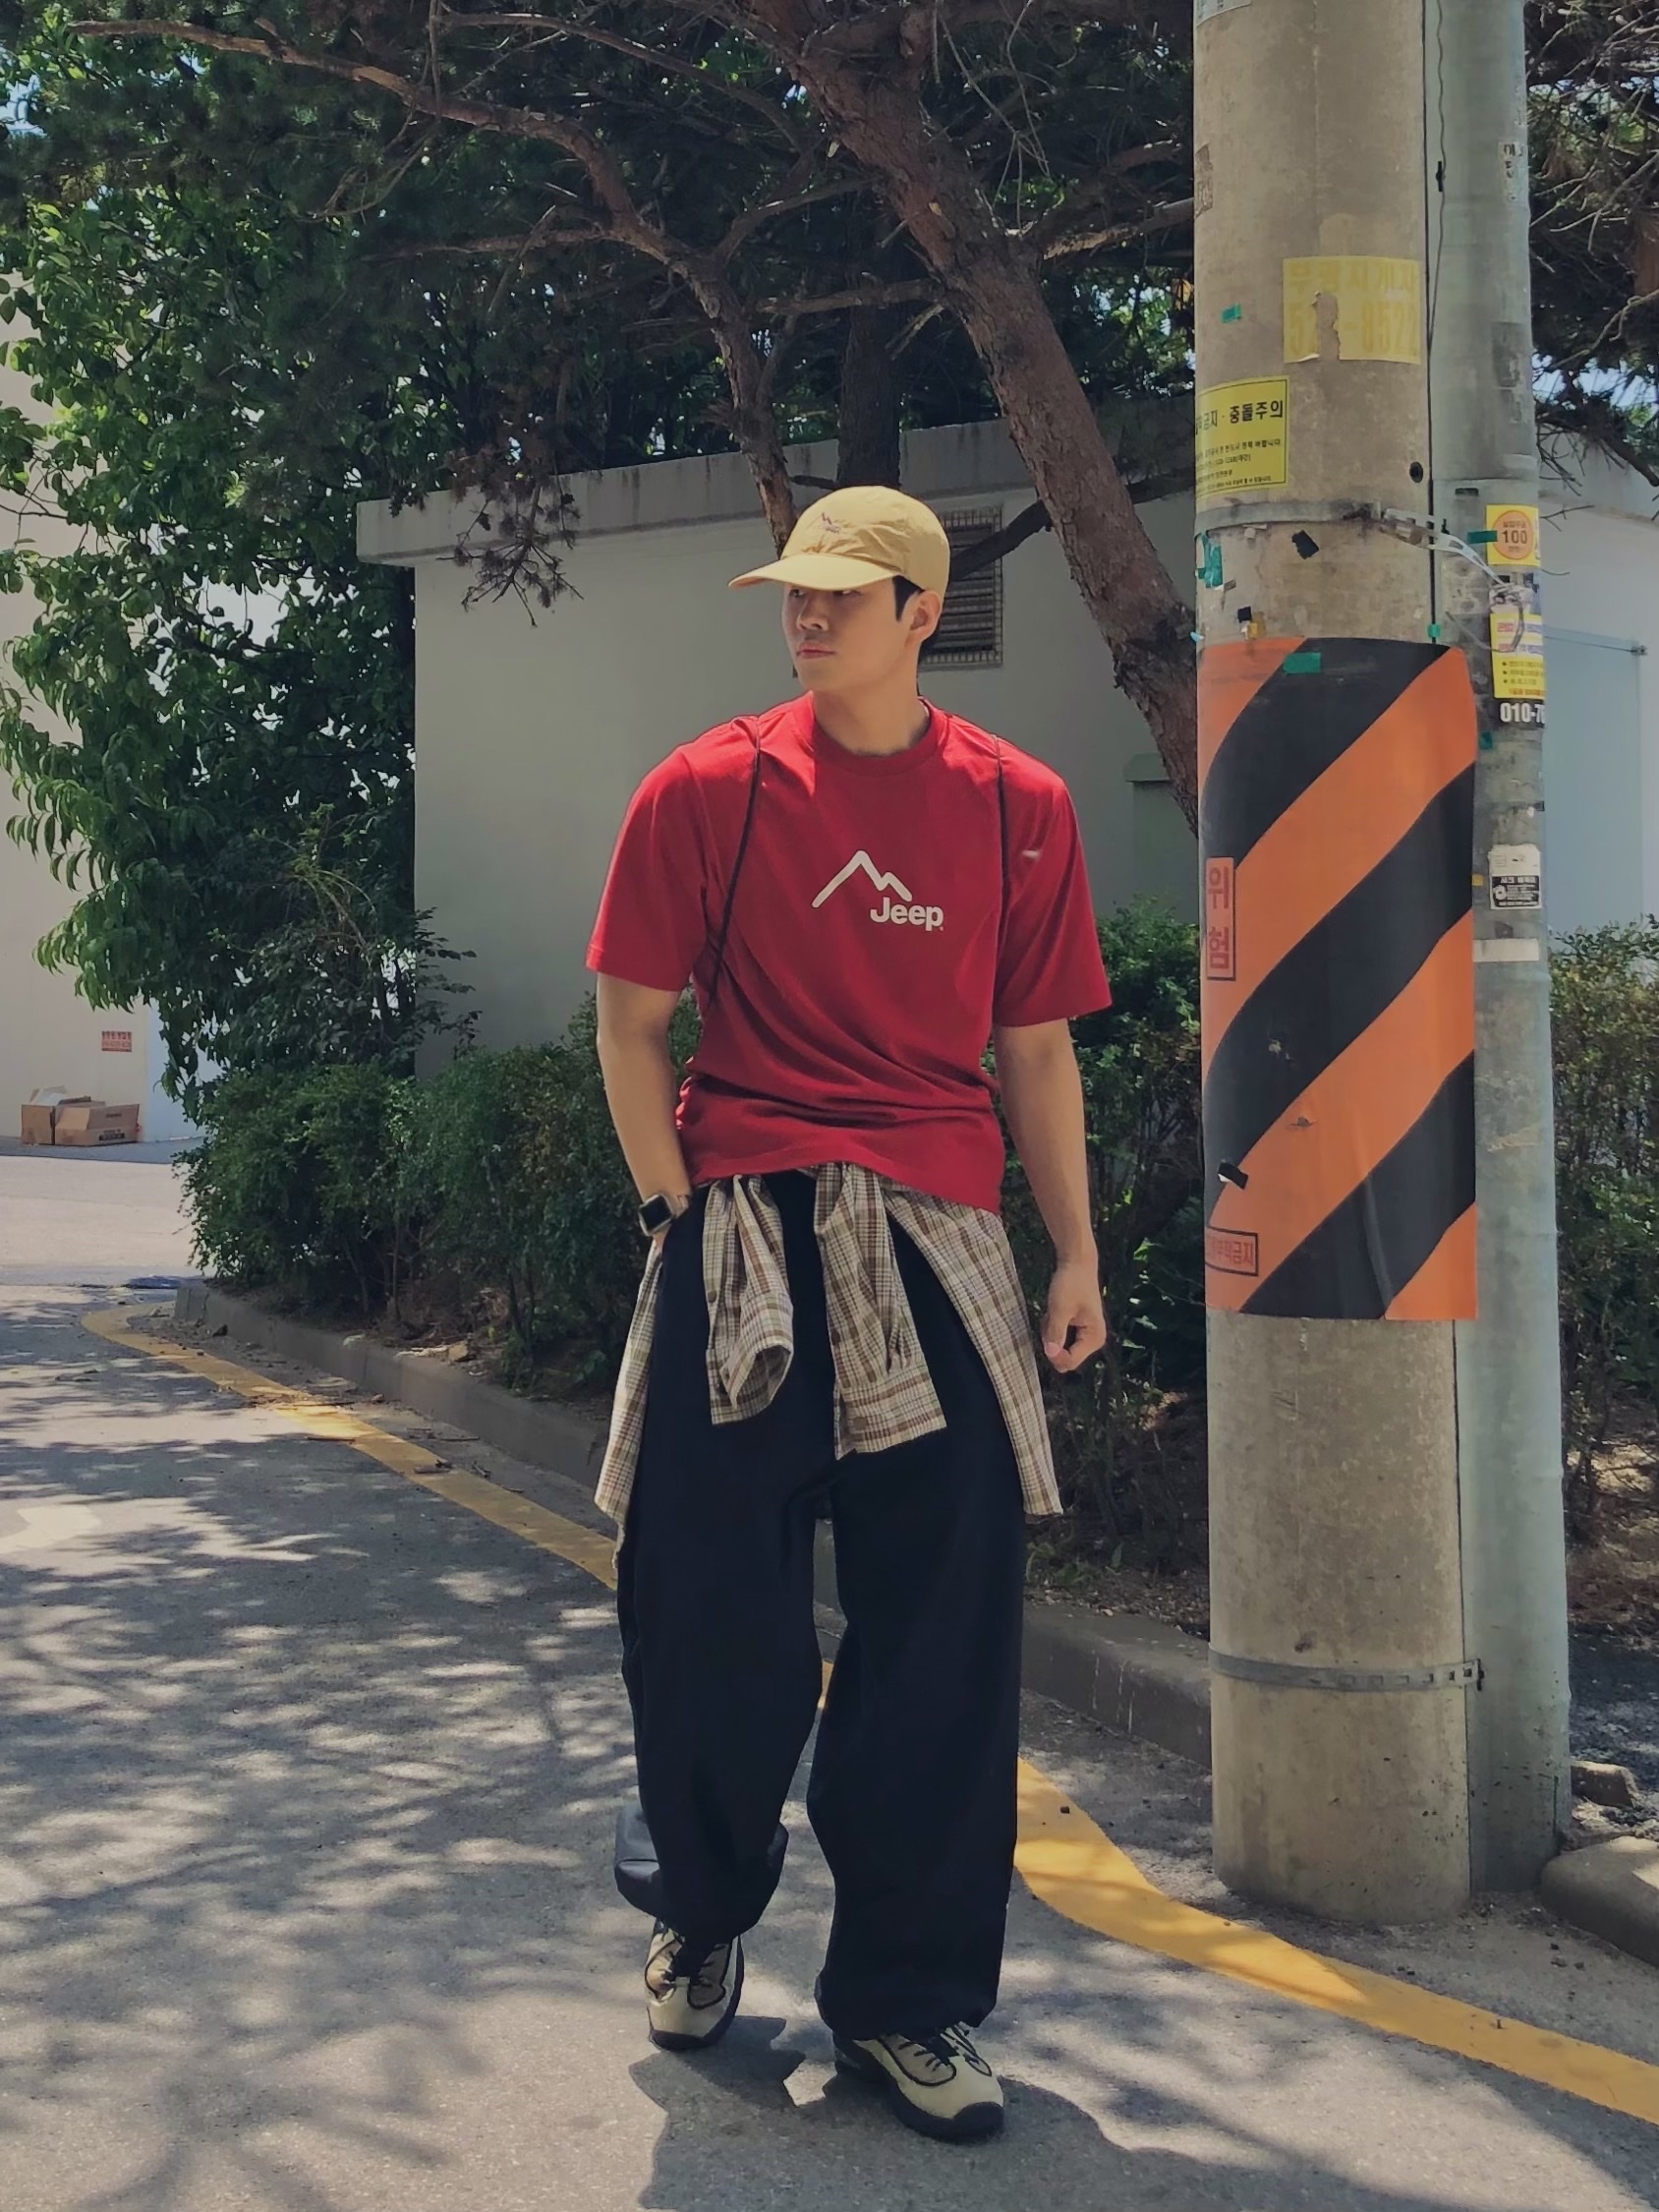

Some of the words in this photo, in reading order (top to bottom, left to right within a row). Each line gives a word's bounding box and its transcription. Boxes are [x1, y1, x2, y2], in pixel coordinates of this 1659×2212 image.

[1230, 400, 1283, 424] 충돌주의
[1502, 530, 1527, 544] 100
[870, 897, 944, 931] Jeep
[1209, 866, 1230, 969] 위험
